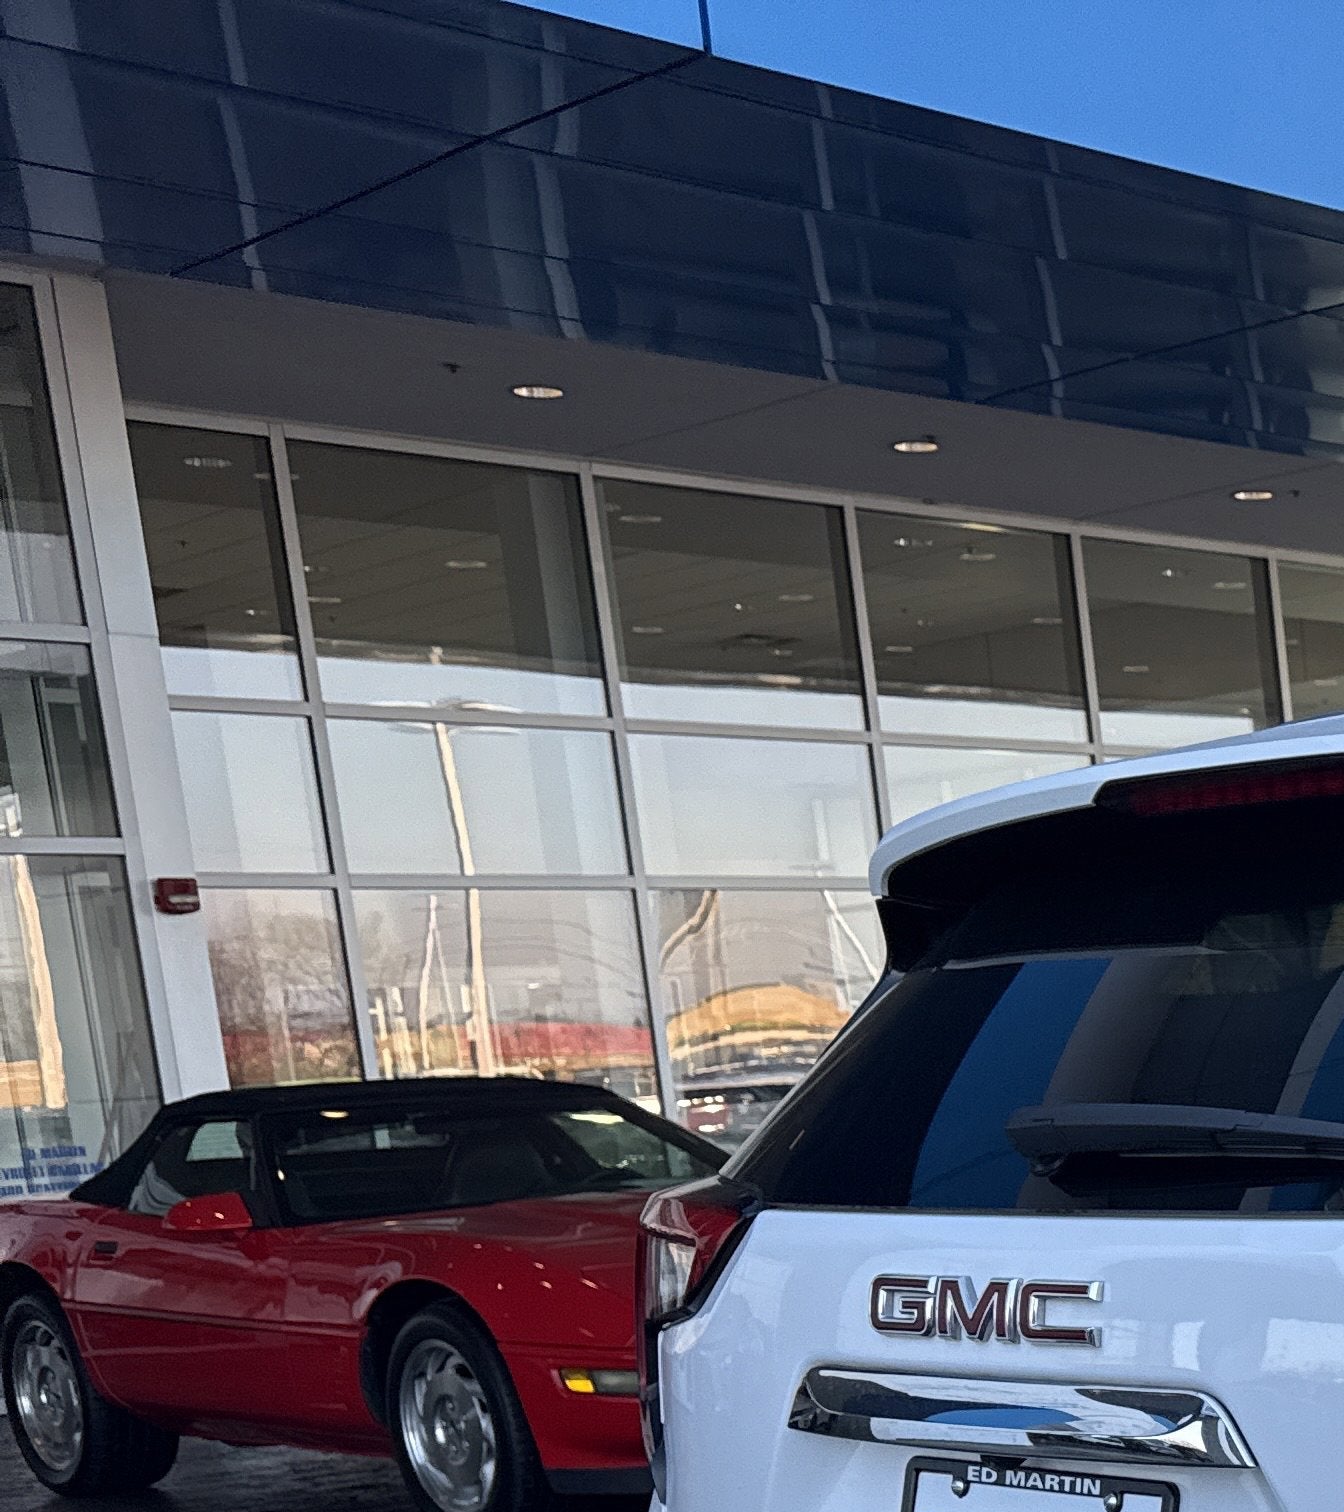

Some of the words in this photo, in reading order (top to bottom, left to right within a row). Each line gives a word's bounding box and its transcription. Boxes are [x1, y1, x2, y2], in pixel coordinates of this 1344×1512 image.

[870, 1273, 1105, 1348] GMC
[967, 1465, 998, 1484] ED
[1004, 1469, 1101, 1496] MARTIN
